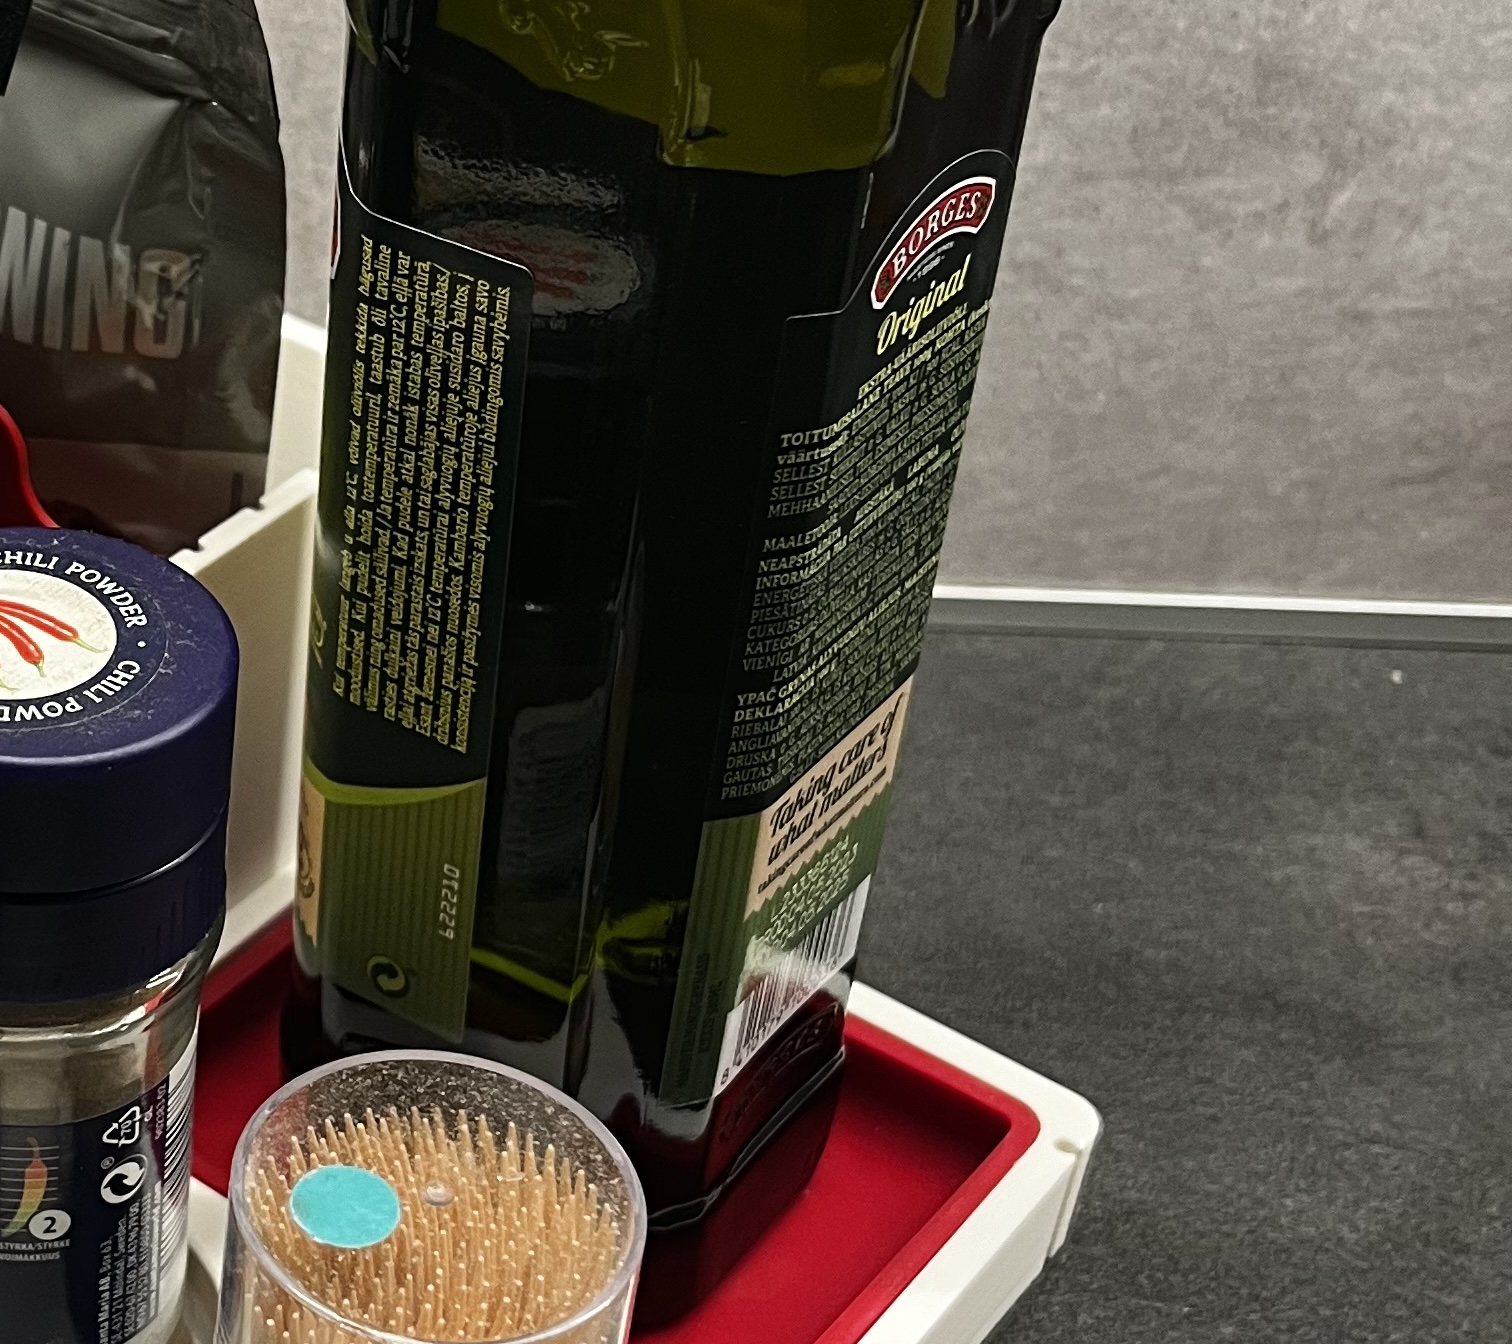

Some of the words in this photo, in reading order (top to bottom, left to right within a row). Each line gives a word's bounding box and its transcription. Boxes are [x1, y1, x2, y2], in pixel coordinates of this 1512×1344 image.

[890, 190, 982, 279] BORGES
[373, 244, 391, 300] tavaline
[397, 251, 410, 273] var
[371, 306, 386, 326] õli
[470, 277, 489, 313] savo
[876, 250, 973, 357] Original
[368, 333, 384, 384] taastub
[391, 333, 406, 360] par
[445, 331, 464, 390] susidaro
[385, 359, 402, 411] zemāka
[403, 351, 422, 399] istabas
[459, 364, 484, 411] aliejus
[402, 403, 418, 445] nonāk
[422, 388, 439, 421] visas
[439, 393, 463, 441] aliejuje
[348, 420, 360, 464] võivad
[473, 441, 497, 485] aliejui
[396, 447, 414, 483] atkal
[395, 487, 412, 532] pudele
[416, 489, 431, 508] tai
[356, 509, 372, 545] hoida
[391, 531, 408, 559] Kad
[448, 507, 468, 570] Kambario
[65, 561, 148, 629] POWDER
[353, 550, 374, 596] pudelit
[465, 550, 484, 598] visomis
[351, 598, 366, 622] Kui
[369, 575, 386, 638] omadused
[406, 574, 426, 632] parastais
[368, 638, 385, 669] ning
[422, 621, 439, 643] nei
[88, 659, 141, 706] CHILI
[736, 685, 777, 707] YPAČ
[769, 761, 838, 838] Taking
[839, 723, 880, 775] care
[881, 690, 907, 736] of
[767, 799, 819, 867] what
[818, 736, 889, 818] matters
[42, 1214, 57, 1235] 2
[99, 1251, 111, 1275] Box
[97, 1289, 109, 1324] Maria
